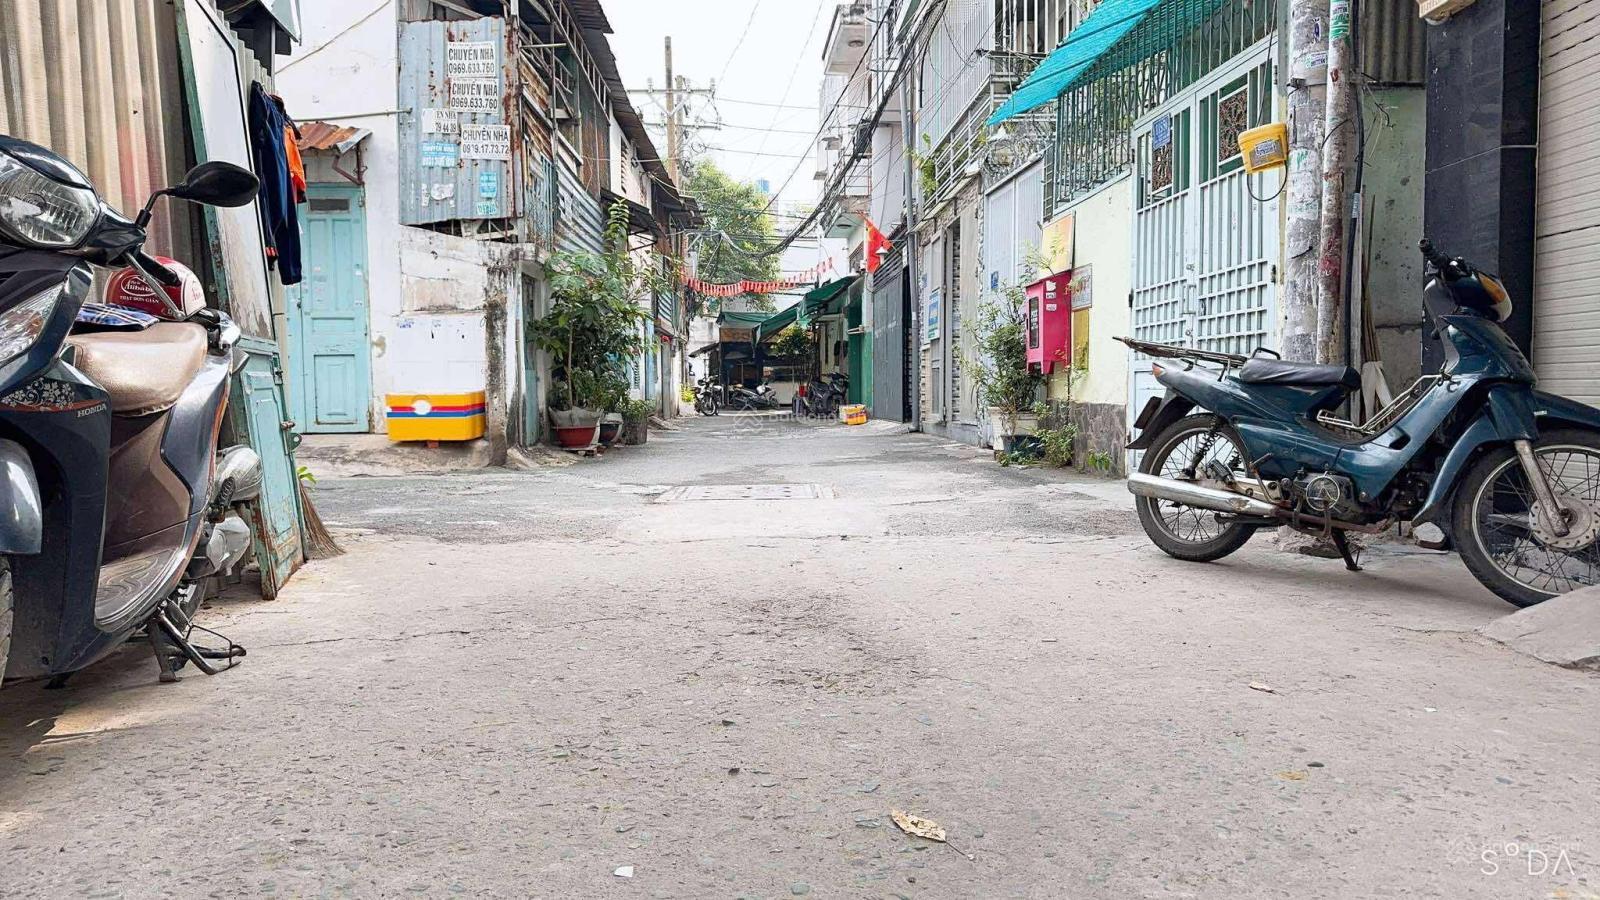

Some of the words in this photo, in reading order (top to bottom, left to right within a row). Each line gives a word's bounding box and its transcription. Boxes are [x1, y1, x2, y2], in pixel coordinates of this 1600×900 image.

[449, 63, 495, 74] 0969.633.760
[451, 97, 498, 110] 0969.633.760
[77, 403, 107, 418] HONDA
